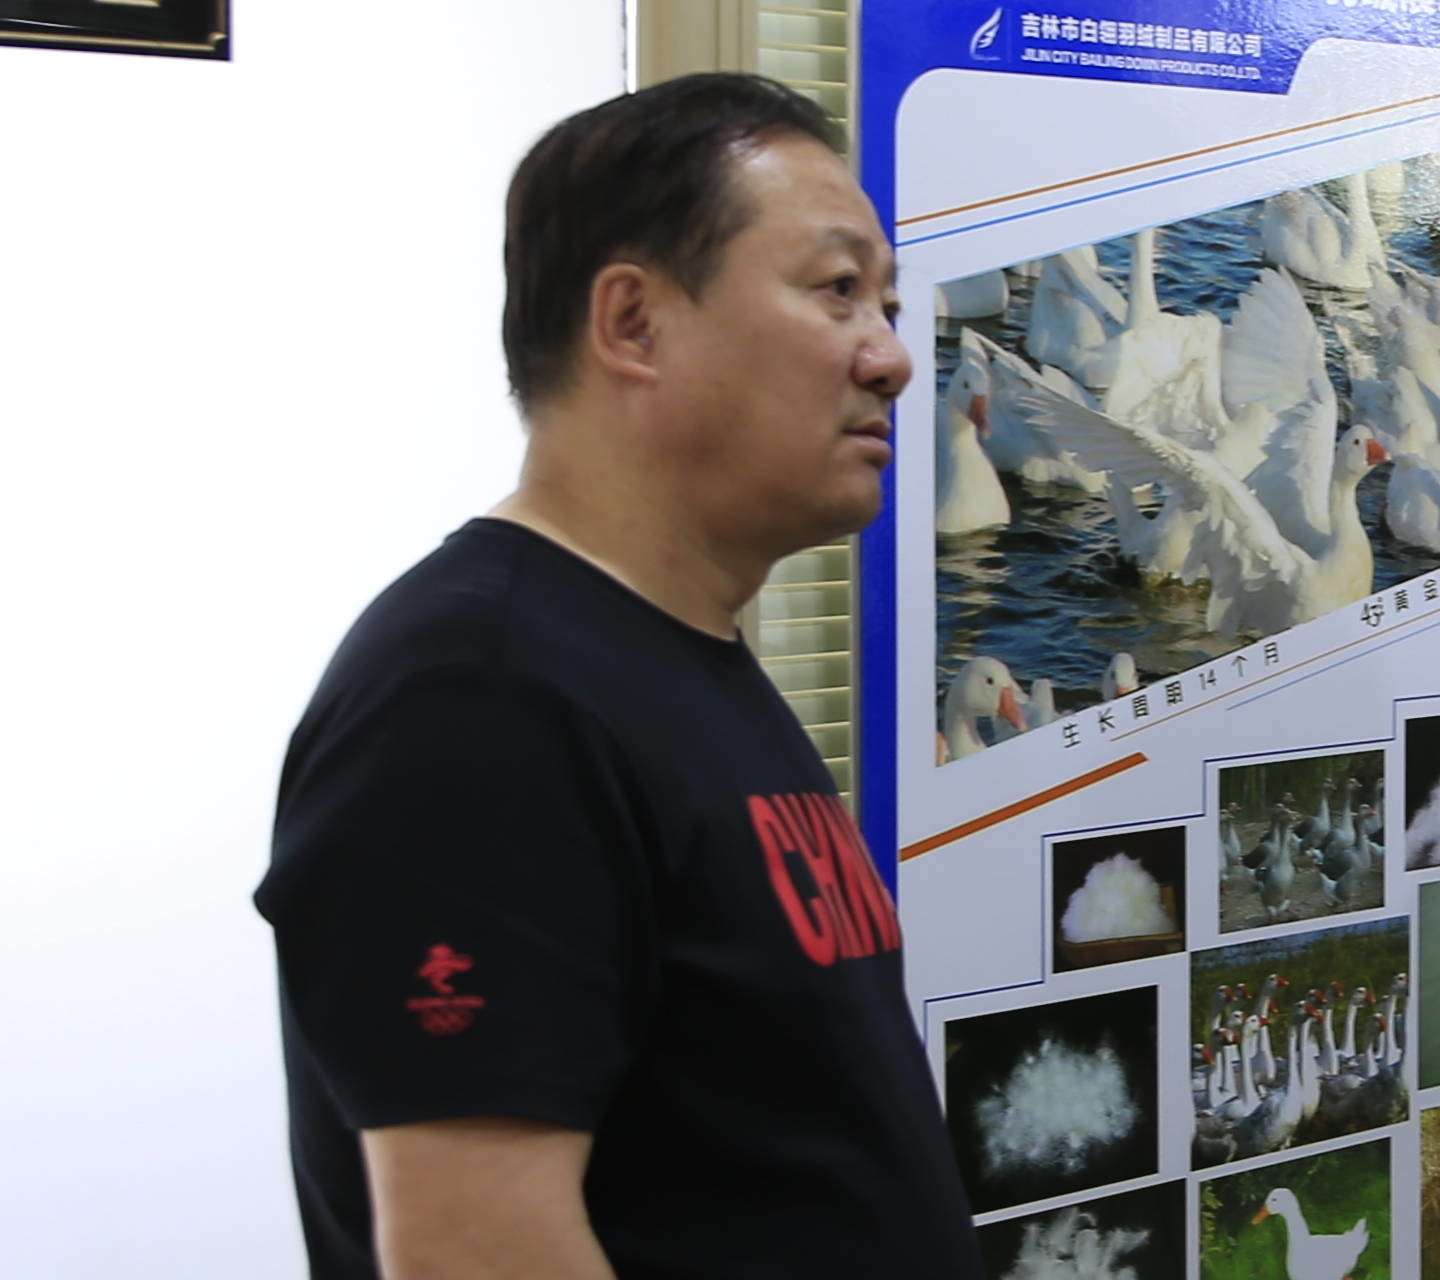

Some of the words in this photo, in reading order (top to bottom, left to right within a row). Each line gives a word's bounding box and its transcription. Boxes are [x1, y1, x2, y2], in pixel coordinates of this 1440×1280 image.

[1020, 47, 1050, 62] JILIN
[1052, 50, 1080, 65] CITY
[1080, 52, 1125, 69] BAILING
